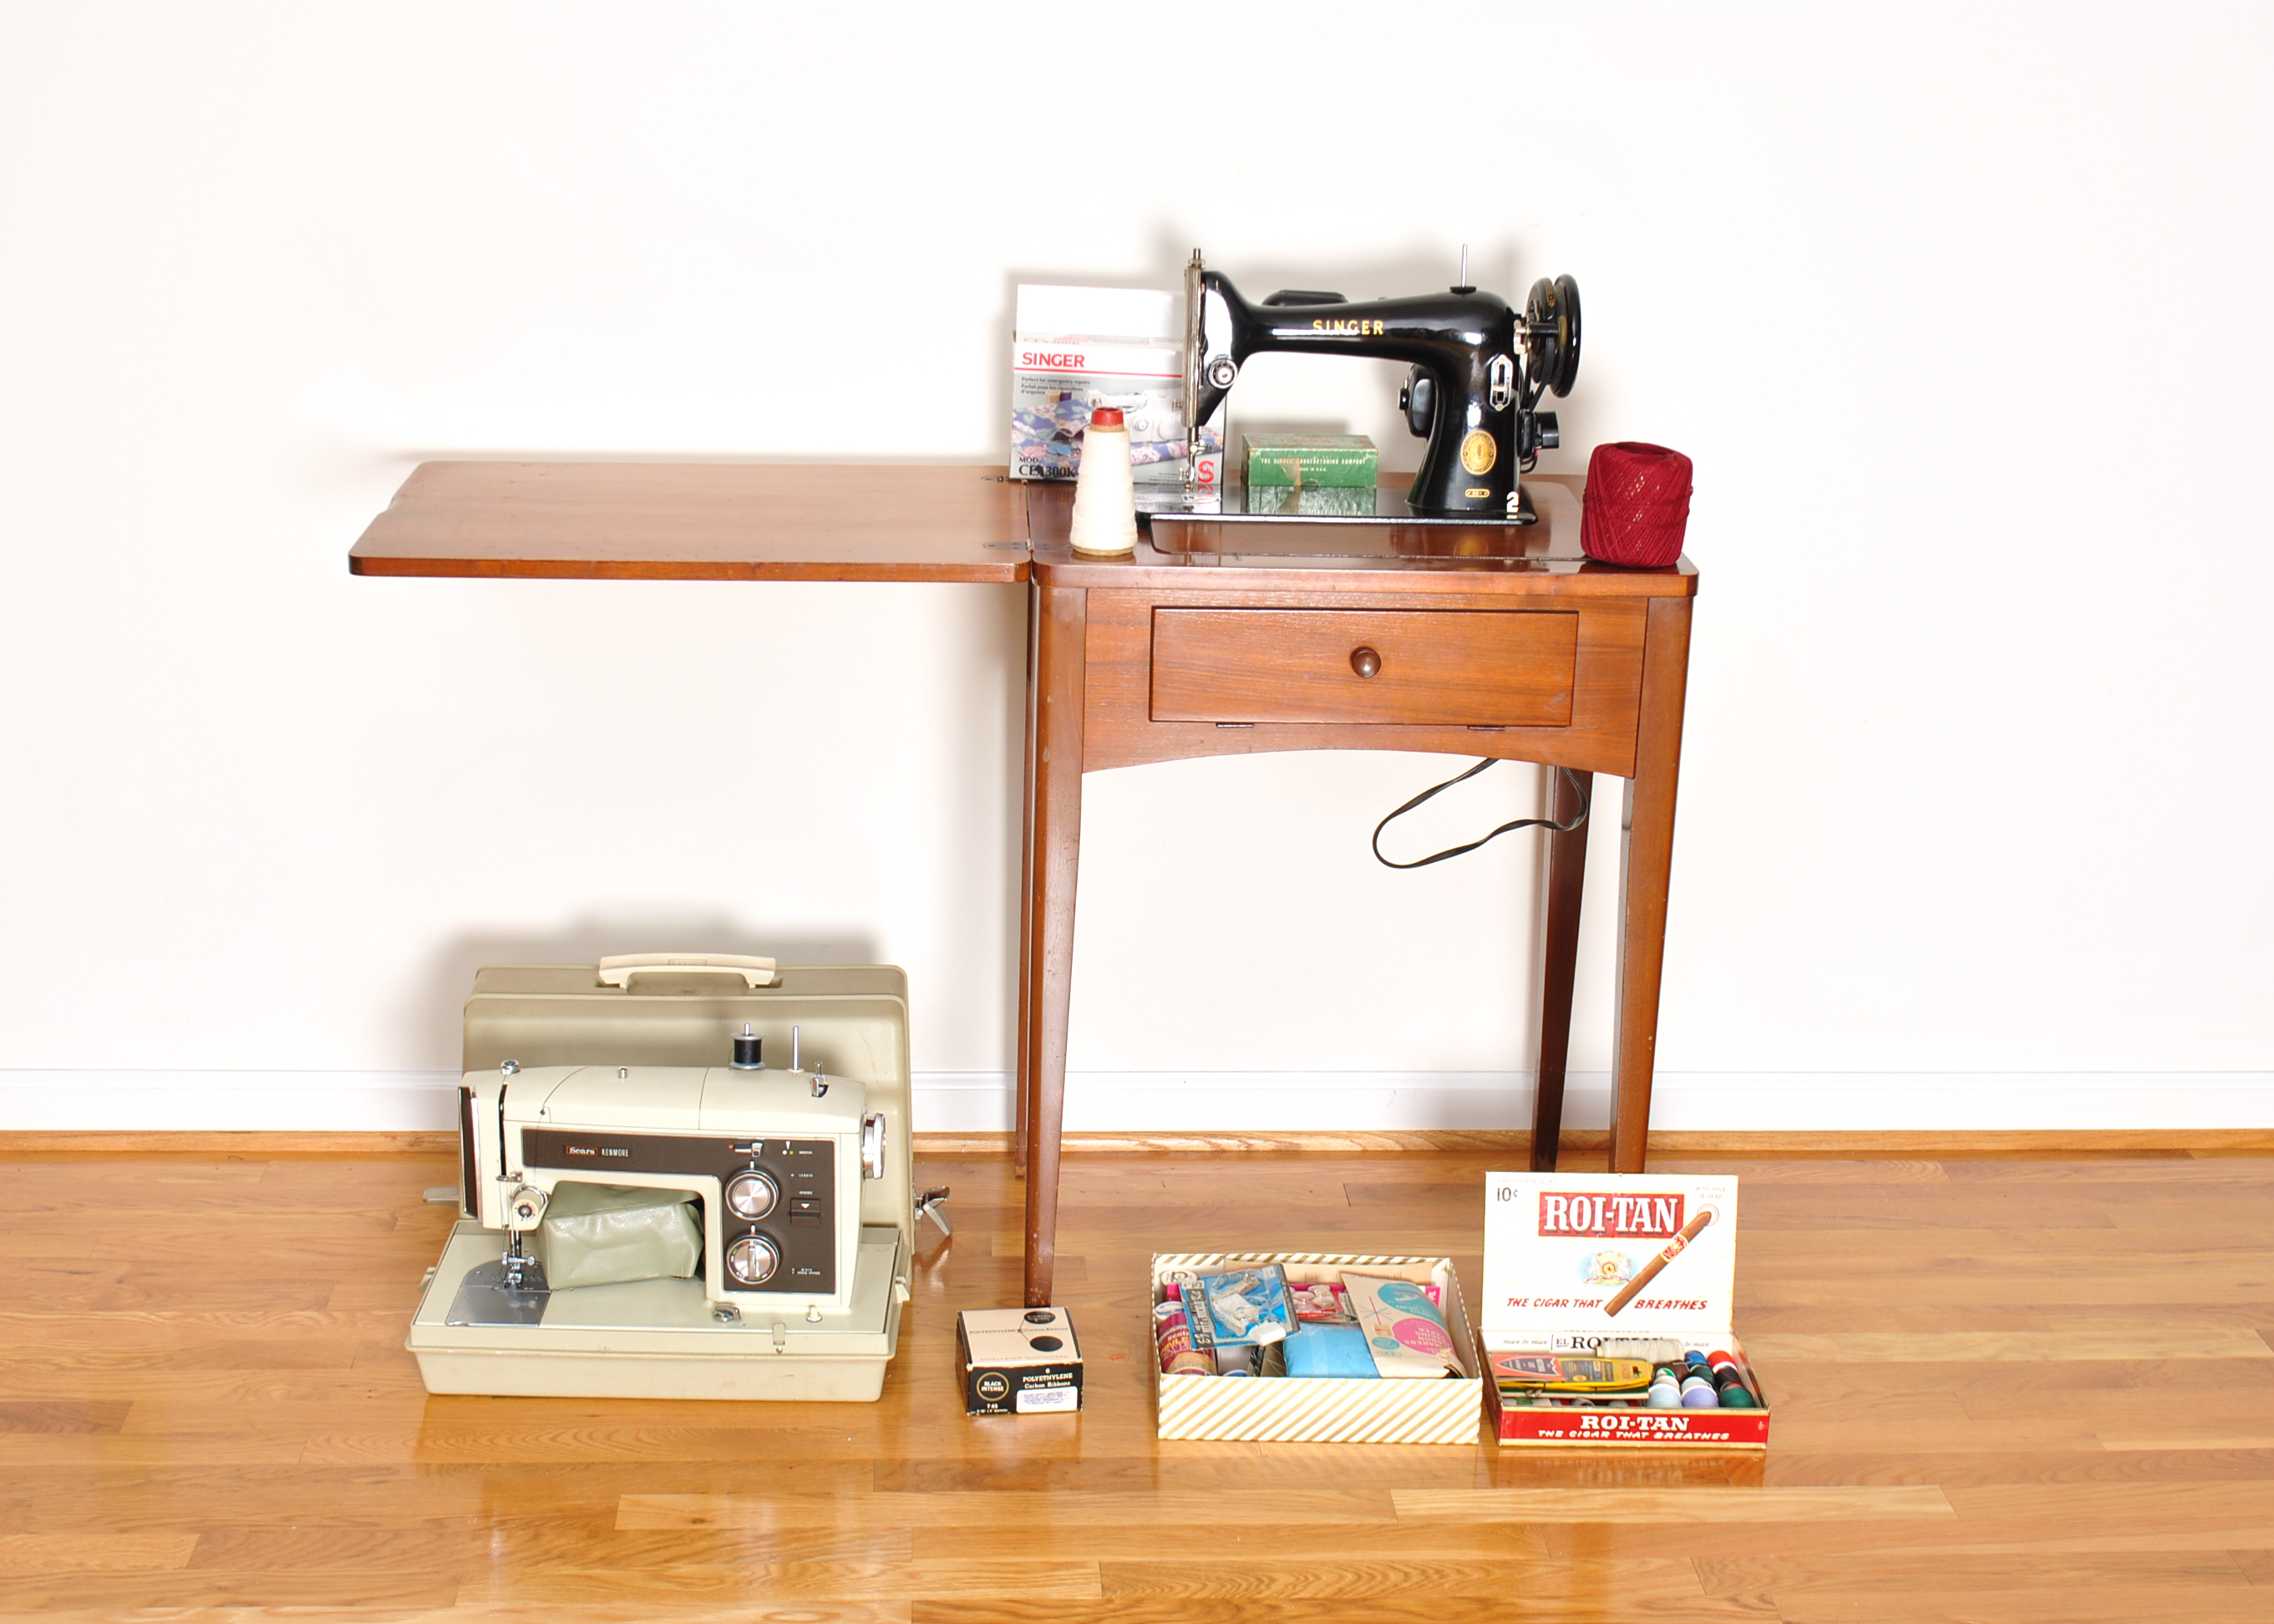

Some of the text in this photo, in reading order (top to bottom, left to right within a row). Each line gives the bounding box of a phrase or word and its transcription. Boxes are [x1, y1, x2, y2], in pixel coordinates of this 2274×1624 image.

[1313, 319, 1383, 335] SINGER
[1022, 352, 1085, 368] SINGER
[1198, 460, 1214, 483] S
[569, 1147, 629, 1157] Sears KENMORE
[1544, 1195, 1678, 1232] ROI-TAN
[1506, 1297, 1708, 1310] THE CIGAR THAT BREATHES
[1023, 1373, 1073, 1383] POLYETHYLENE
[1580, 1415, 1689, 1431] ROI-TAN
[1538, 1429, 1730, 1440] THE CIGAR THAT BREATHES
